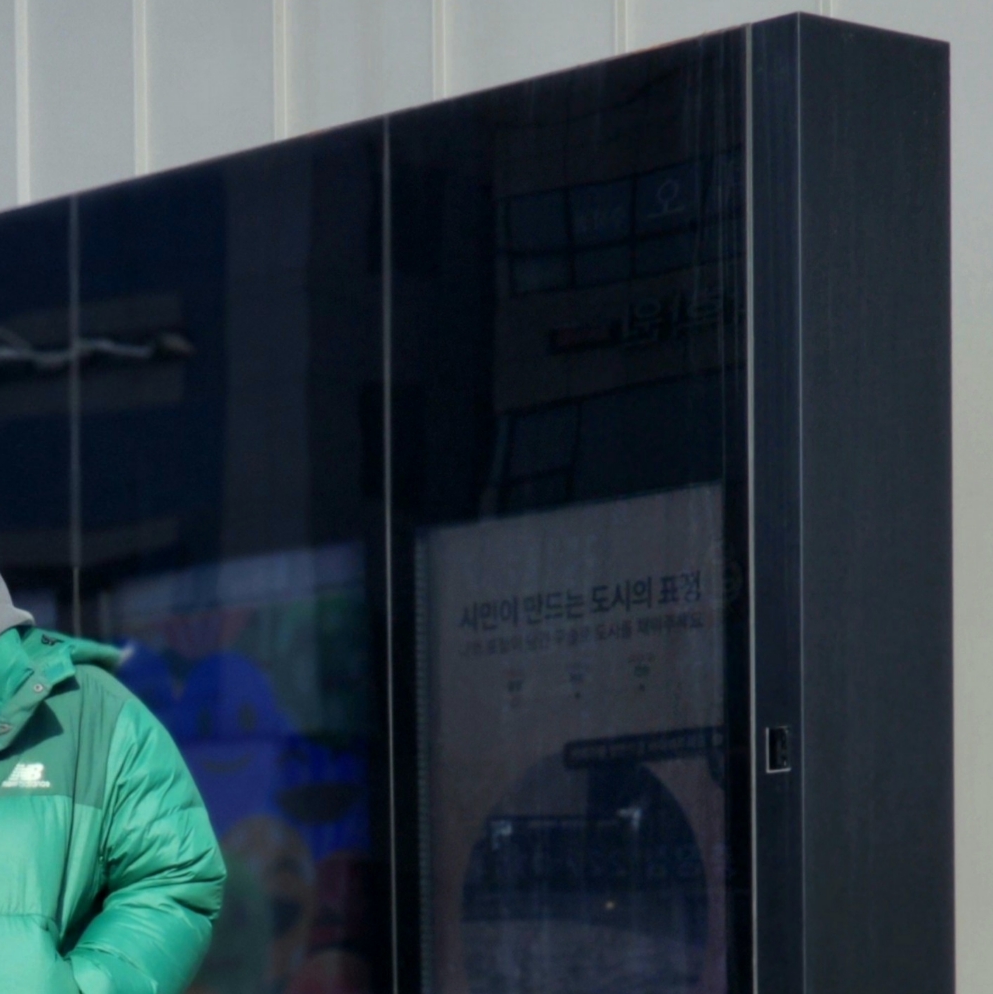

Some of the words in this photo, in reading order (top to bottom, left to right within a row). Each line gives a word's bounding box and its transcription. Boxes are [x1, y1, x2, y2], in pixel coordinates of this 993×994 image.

[460, 596, 518, 631] 시민이
[524, 591, 584, 625] 만드는
[591, 576, 652, 612] 도시의
[658, 571, 702, 605] 표정
